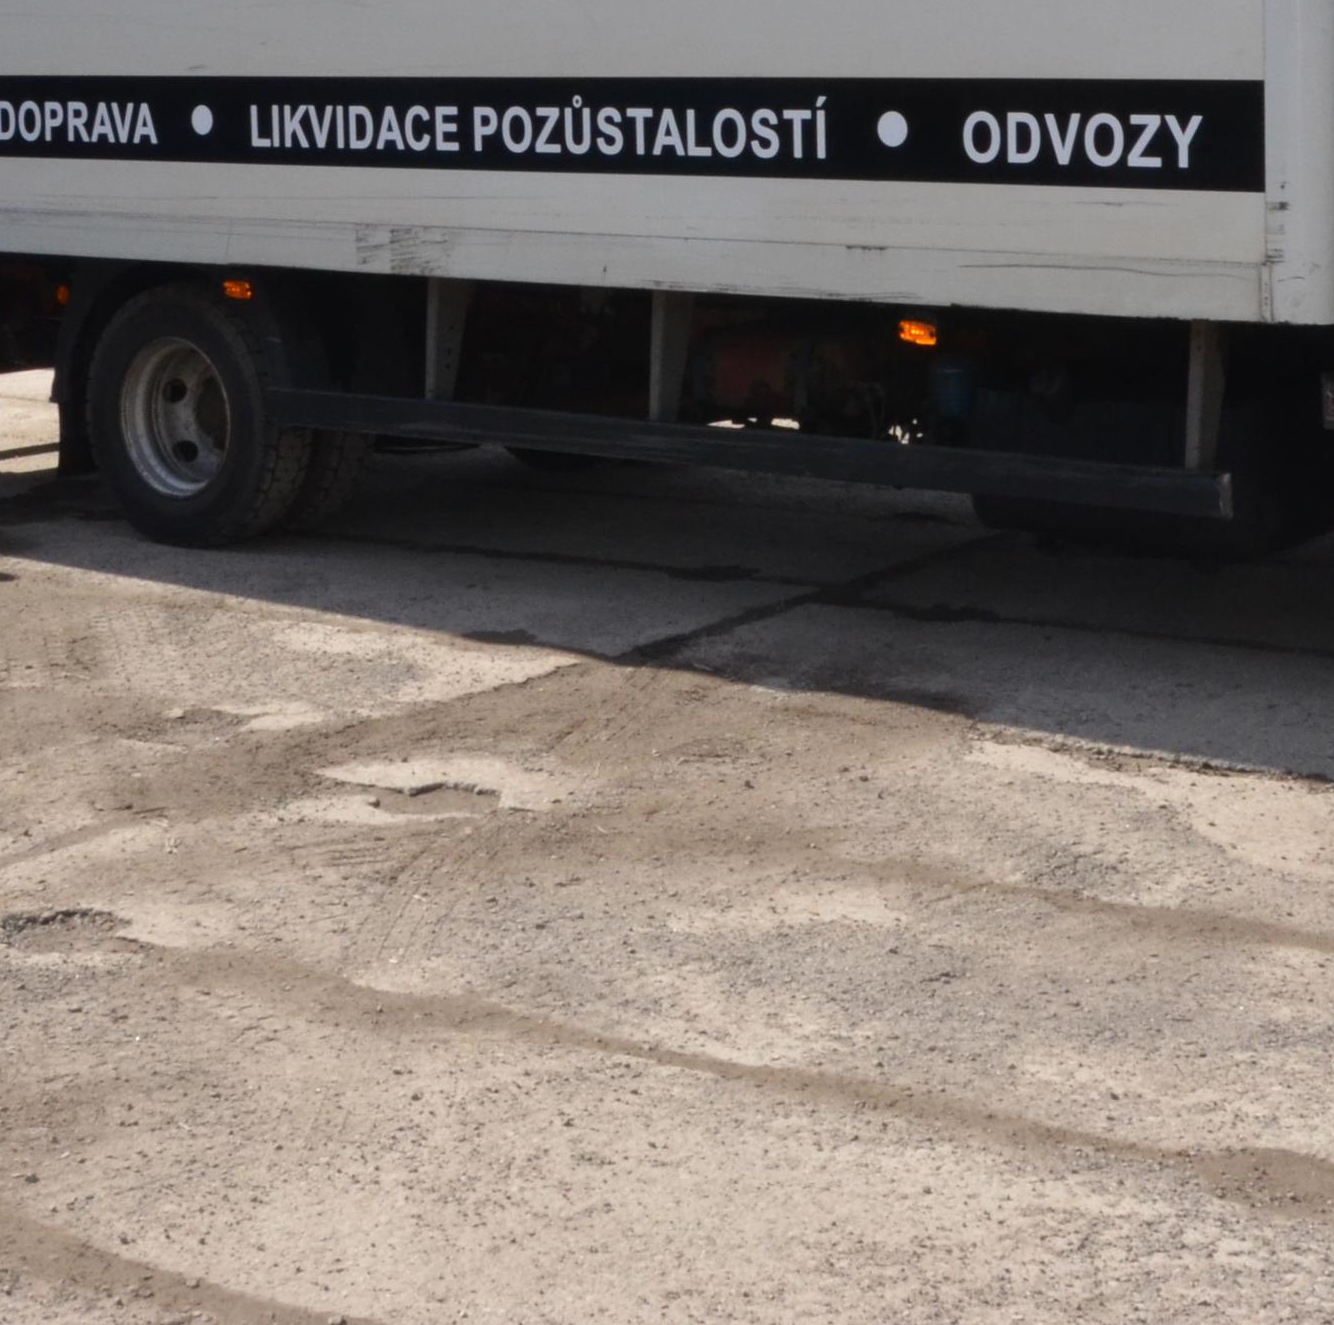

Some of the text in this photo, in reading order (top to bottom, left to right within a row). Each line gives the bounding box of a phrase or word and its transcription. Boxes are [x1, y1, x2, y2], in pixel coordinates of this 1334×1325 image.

[250, 104, 460, 151] LIKVIDACE
[473, 94, 827, 160] POZŮSTALOSTÍ
[962, 110, 1204, 169] ODVOZY
